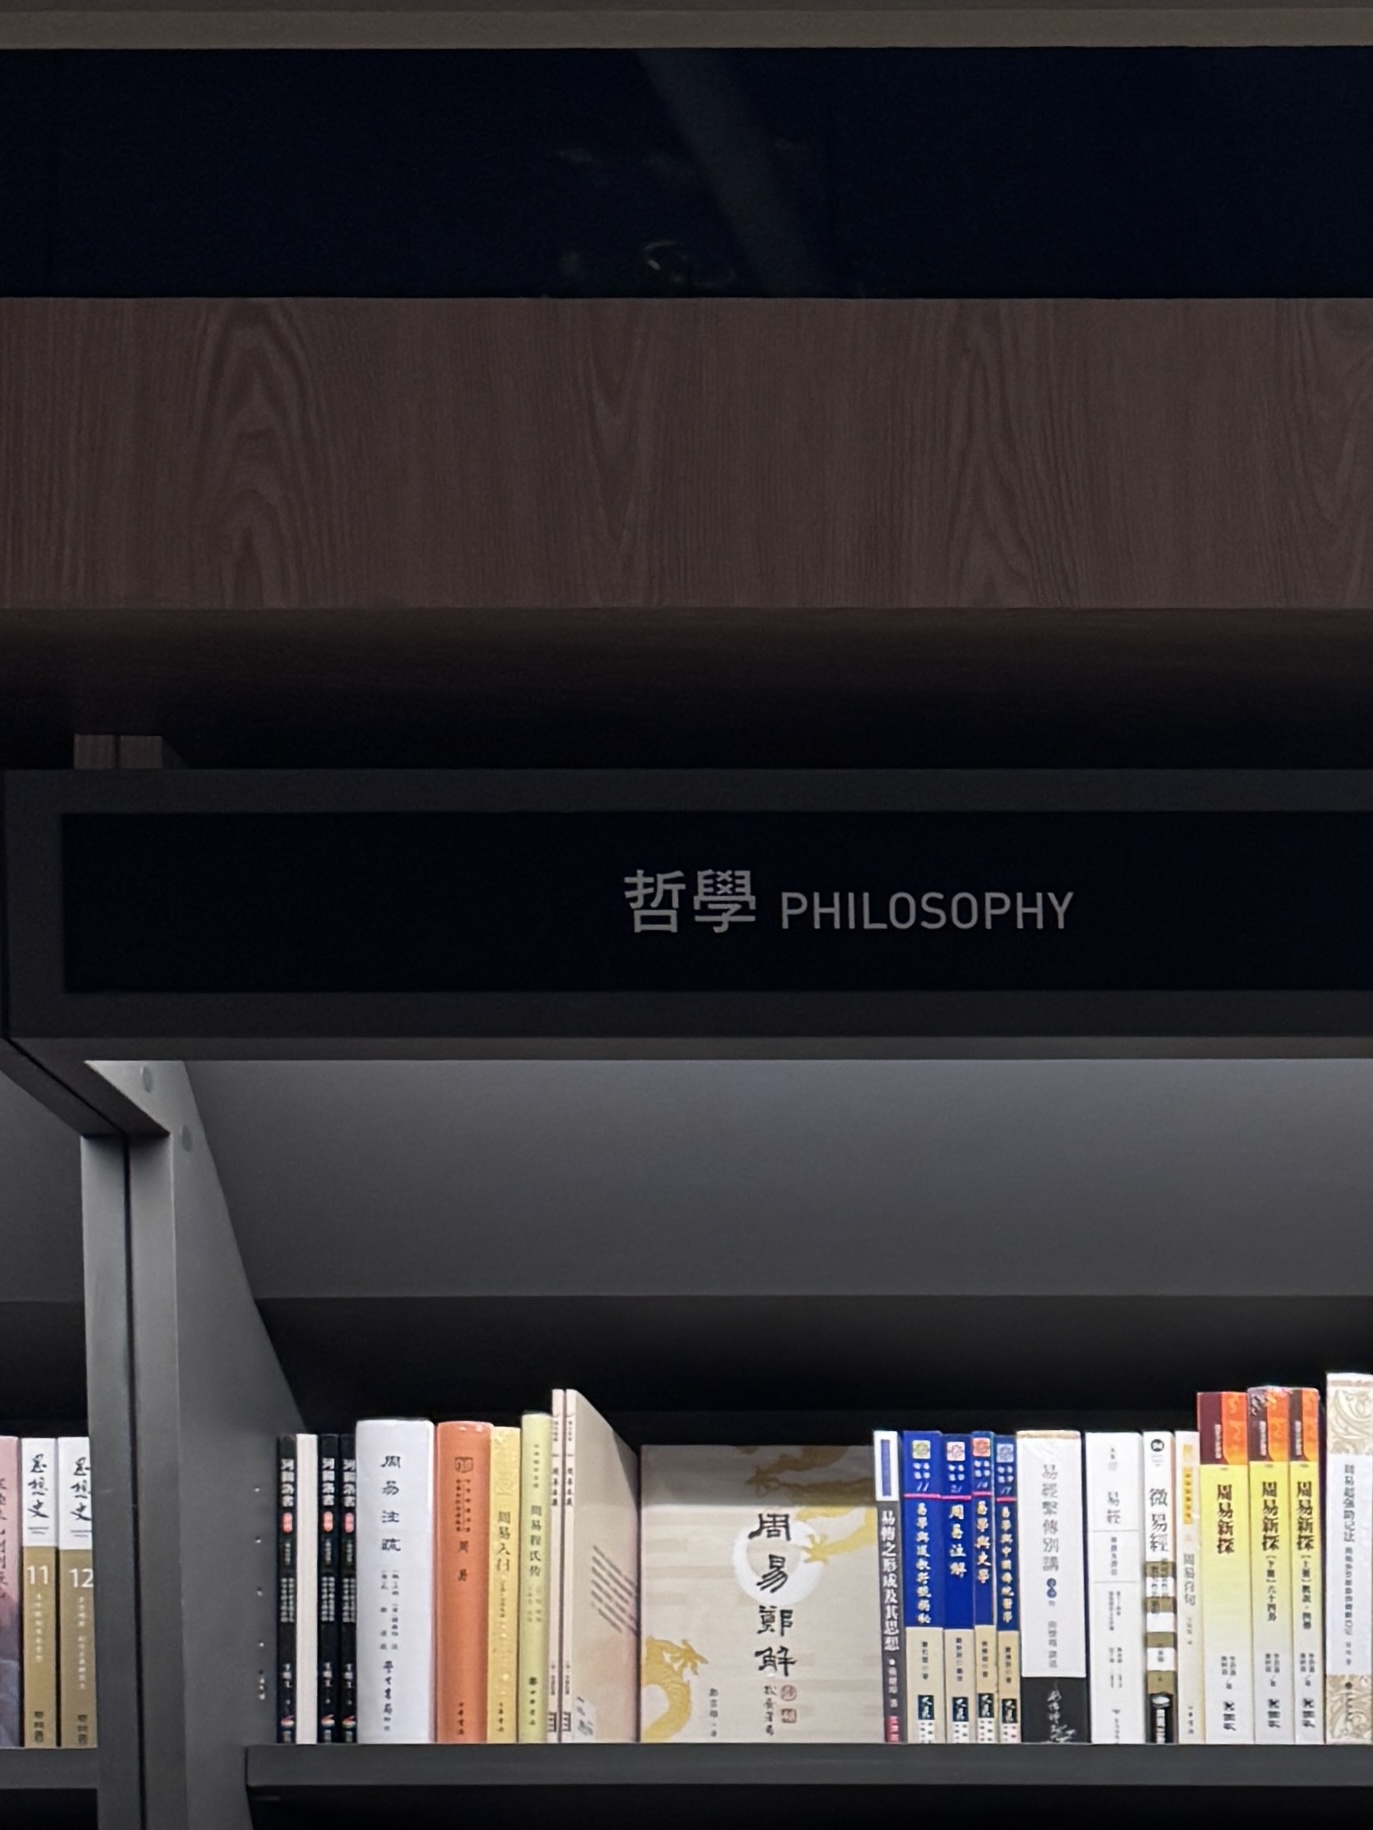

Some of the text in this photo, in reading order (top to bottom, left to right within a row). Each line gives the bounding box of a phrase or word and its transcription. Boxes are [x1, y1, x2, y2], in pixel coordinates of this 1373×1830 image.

[622, 867, 1074, 934] 哲學 PHILOSOPHY
[1150, 1488, 1170, 1553] 微易經
[27, 1566, 49, 1585] 11
[70, 1568, 95, 1587] 12
